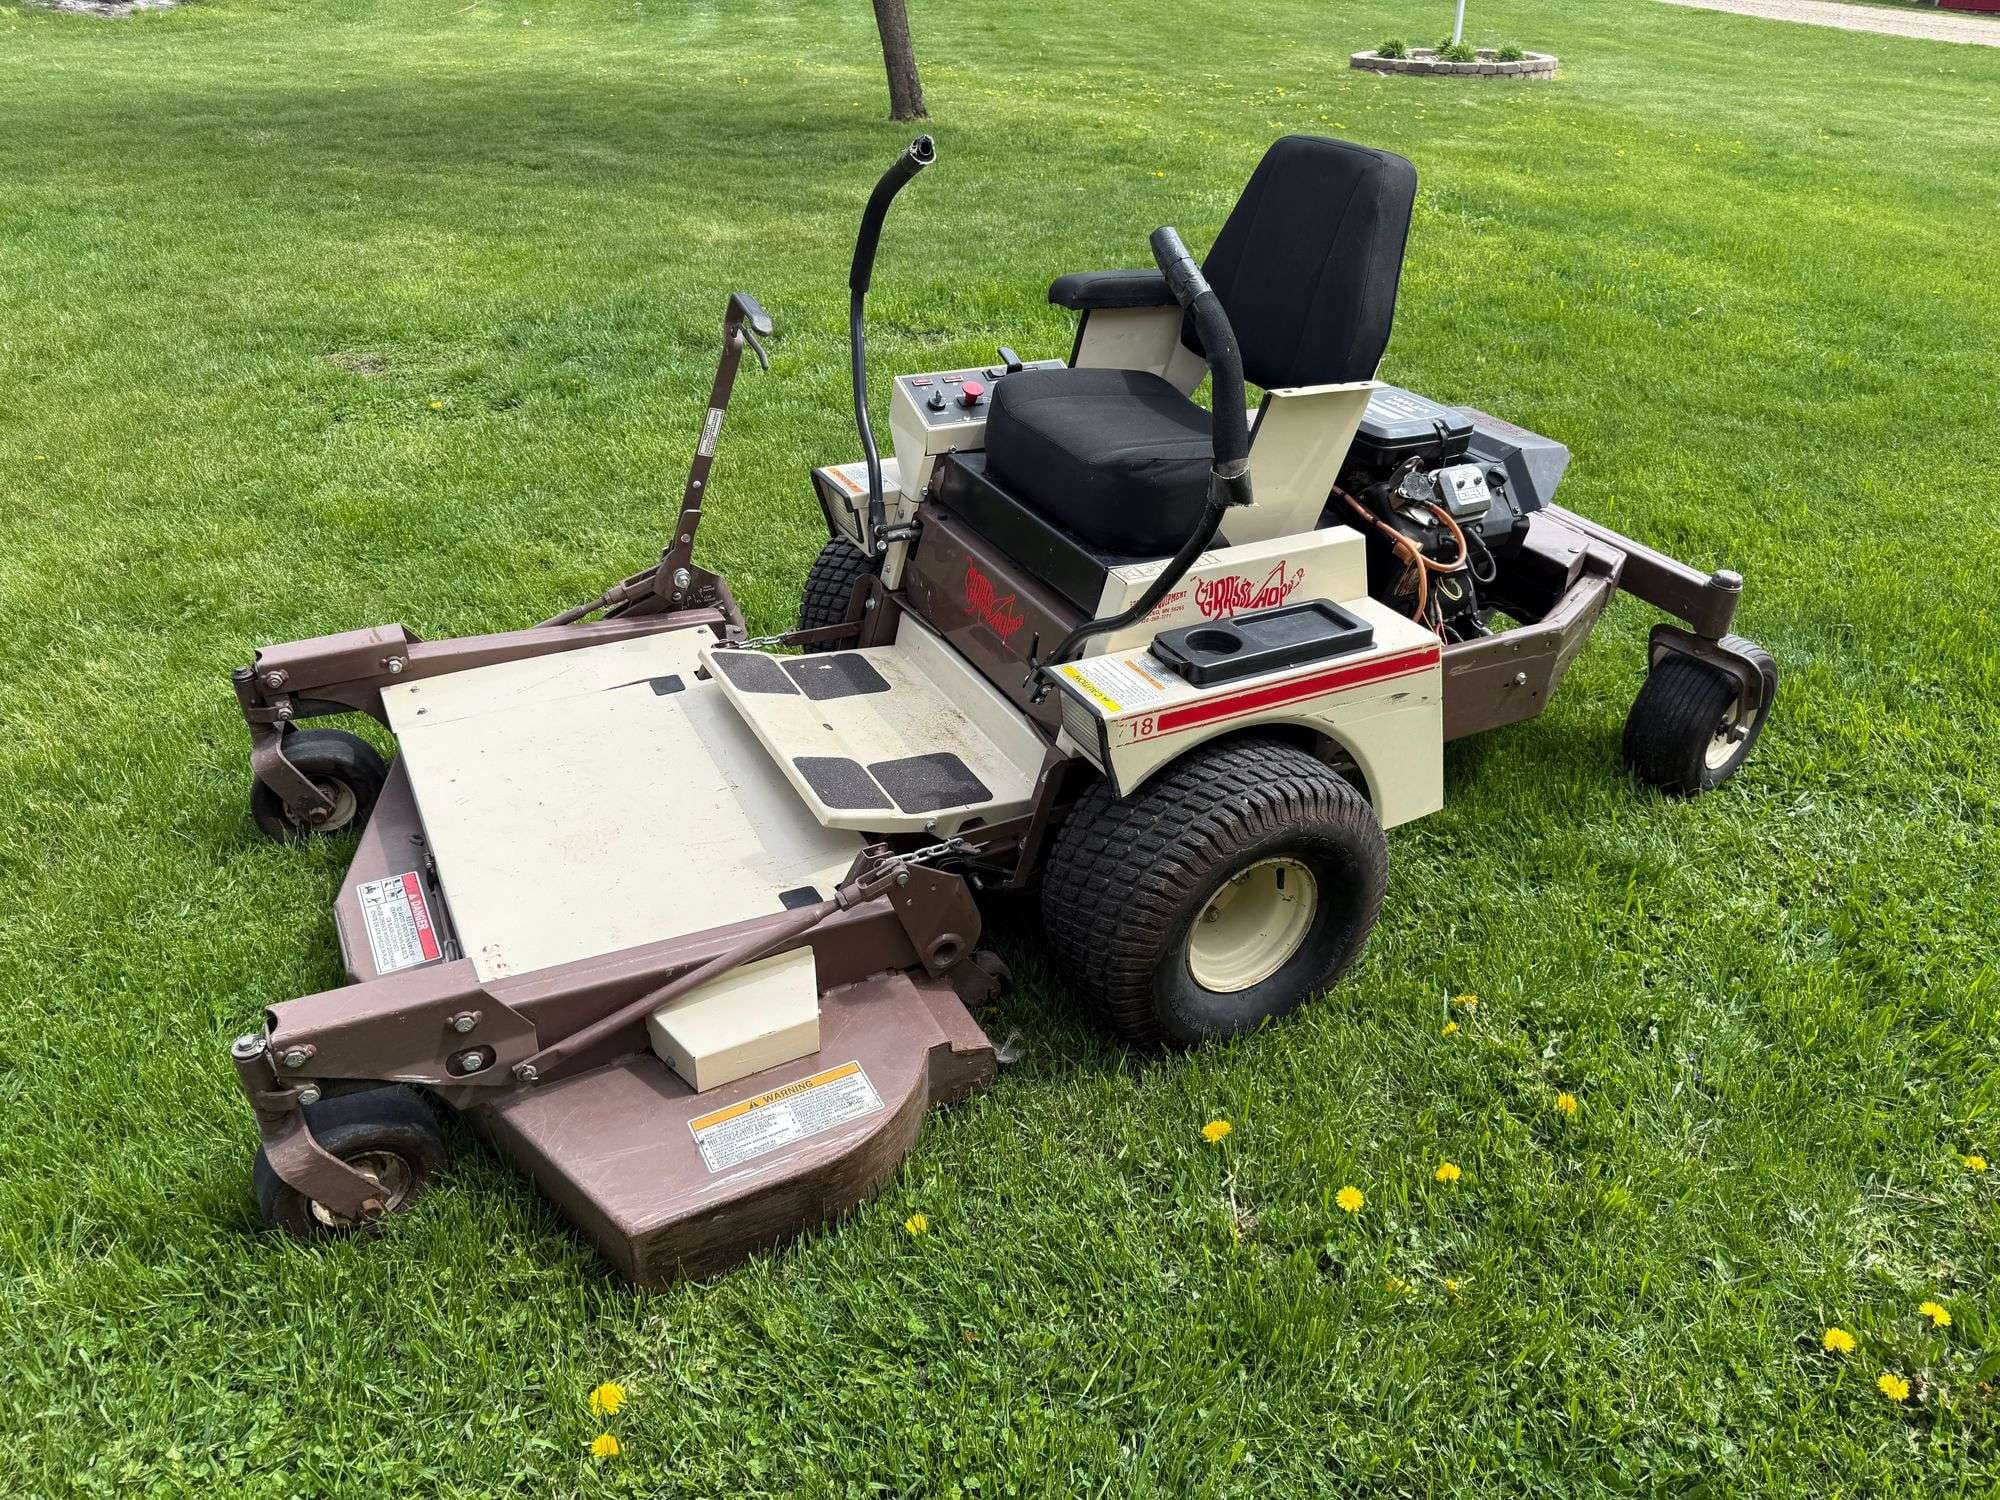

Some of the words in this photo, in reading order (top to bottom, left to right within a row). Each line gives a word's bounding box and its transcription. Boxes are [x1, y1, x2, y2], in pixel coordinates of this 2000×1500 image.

[1130, 718, 1153, 737] 18
[411, 900, 429, 930] DANGER
[763, 1080, 814, 1103] WARNING
